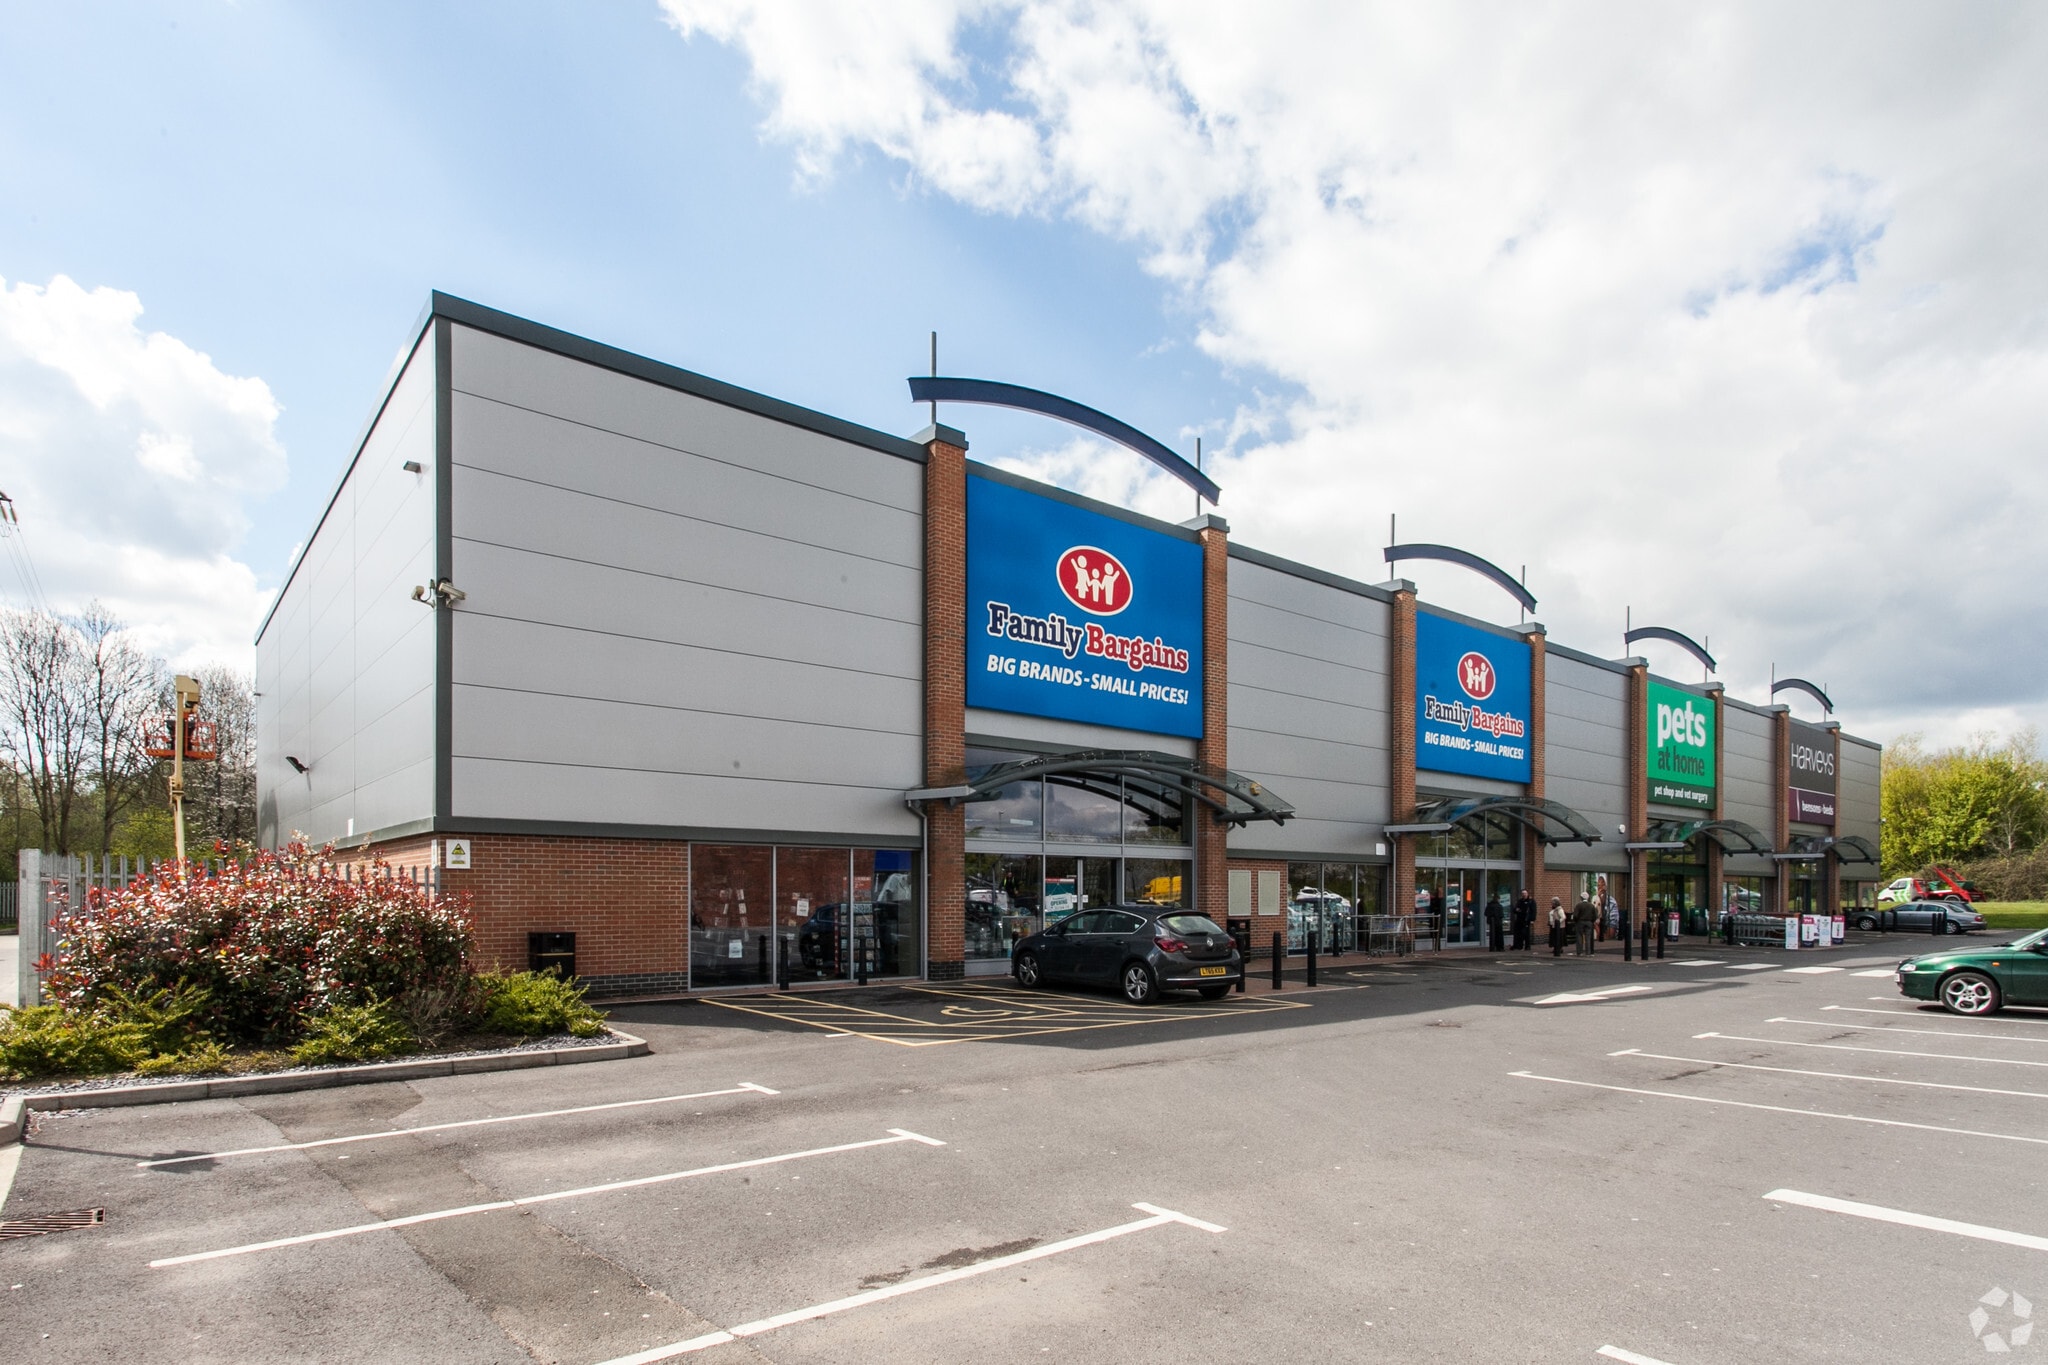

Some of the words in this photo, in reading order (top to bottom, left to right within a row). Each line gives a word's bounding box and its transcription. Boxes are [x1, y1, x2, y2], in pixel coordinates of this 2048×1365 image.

[987, 600, 1083, 660] Family
[1084, 622, 1189, 673] Bargains
[987, 654, 1016, 675] BIG
[1139, 682, 1189, 705] PRICES!
[1424, 695, 1471, 732] Family
[1471, 705, 1524, 738] Bargains
[1657, 701, 1706, 748] pets
[1425, 732, 1439, 744] BIG
[1499, 744, 1524, 760] PRICES!
[1658, 746, 1670, 771] at
[1673, 745, 1705, 776] home
[1654, 786, 1663, 797] pet
[1663, 785, 1674, 799] shop
[1675, 788, 1684, 798] and
